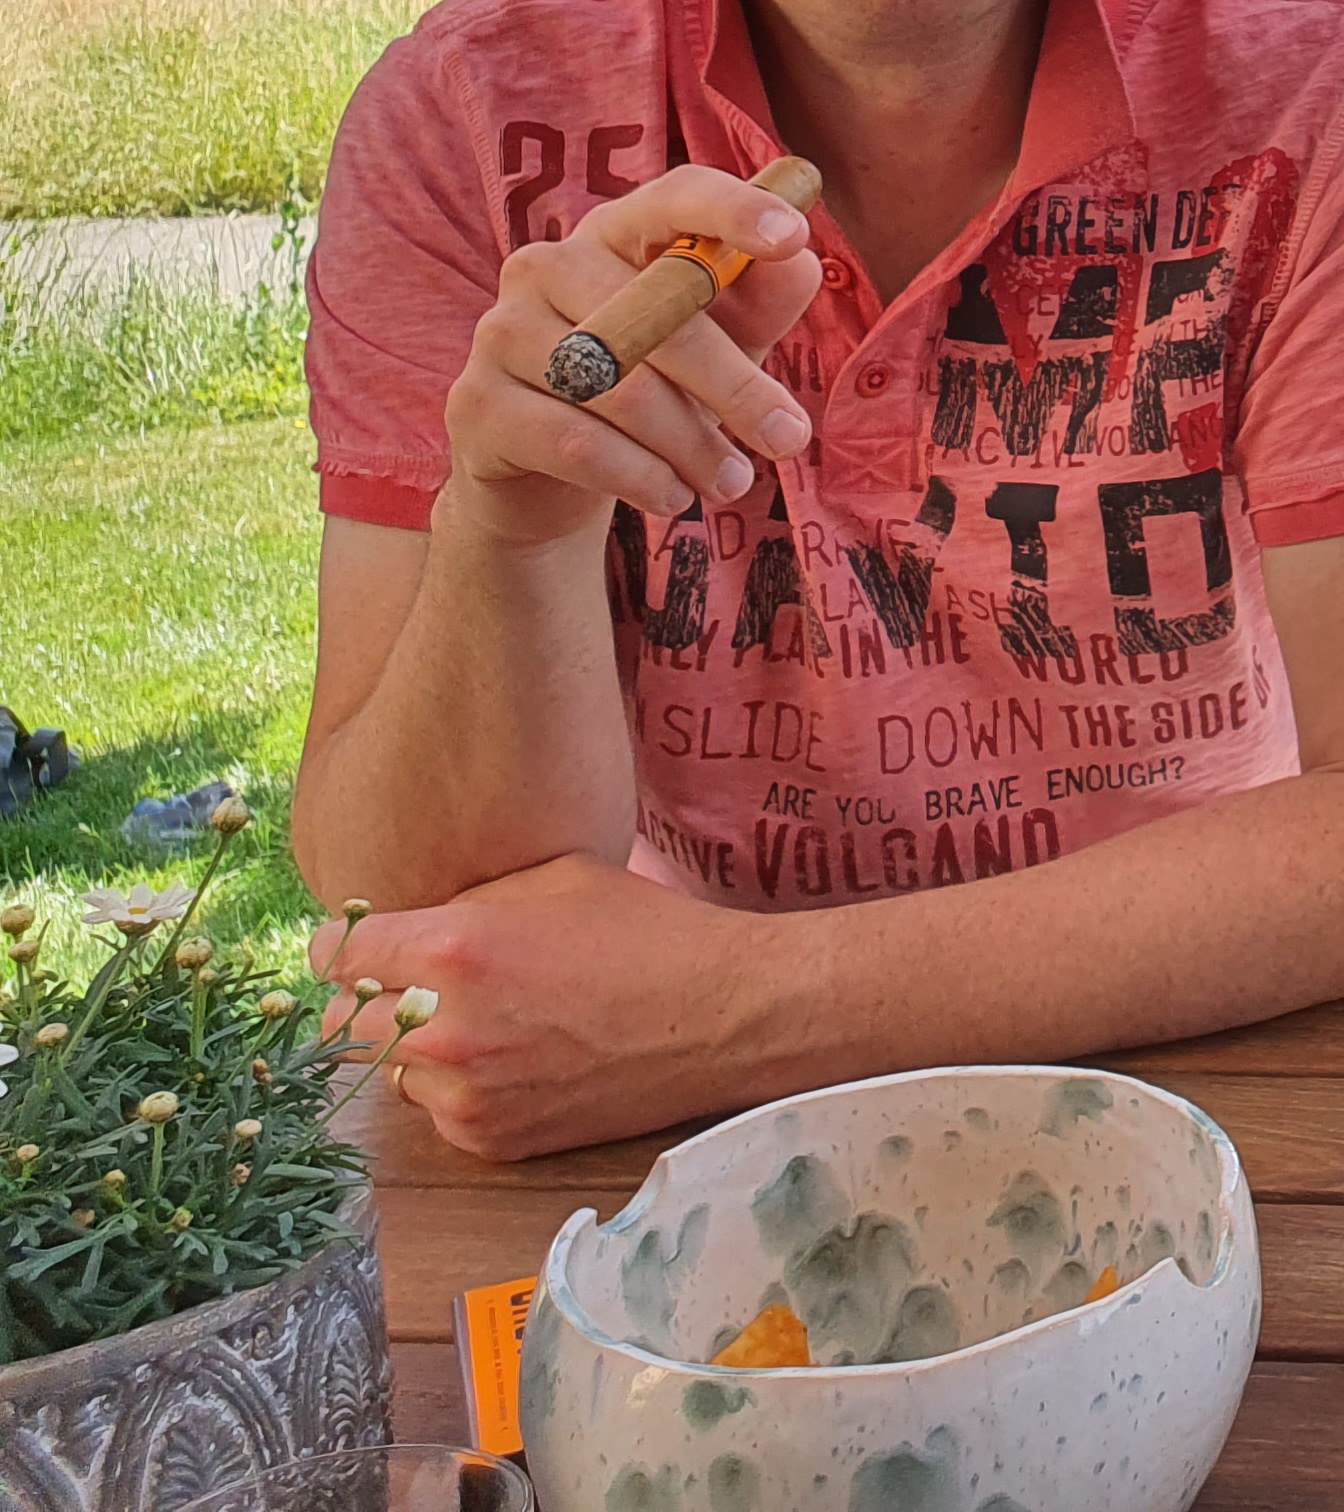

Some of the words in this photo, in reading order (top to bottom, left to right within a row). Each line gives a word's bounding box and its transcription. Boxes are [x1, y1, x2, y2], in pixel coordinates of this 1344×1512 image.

[1012, 188, 1160, 257] GREEN
[659, 700, 827, 772] SLIDE
[876, 697, 1045, 775] DOWN
[1058, 704, 1137, 748] THE
[1150, 681, 1249, 744] SIDE
[762, 781, 818, 820] ARE
[834, 795, 896, 826] YOU
[924, 774, 1023, 822] BRAVE
[1046, 755, 1186, 802] ENOUGH?
[754, 807, 1062, 899] VOLCANO
